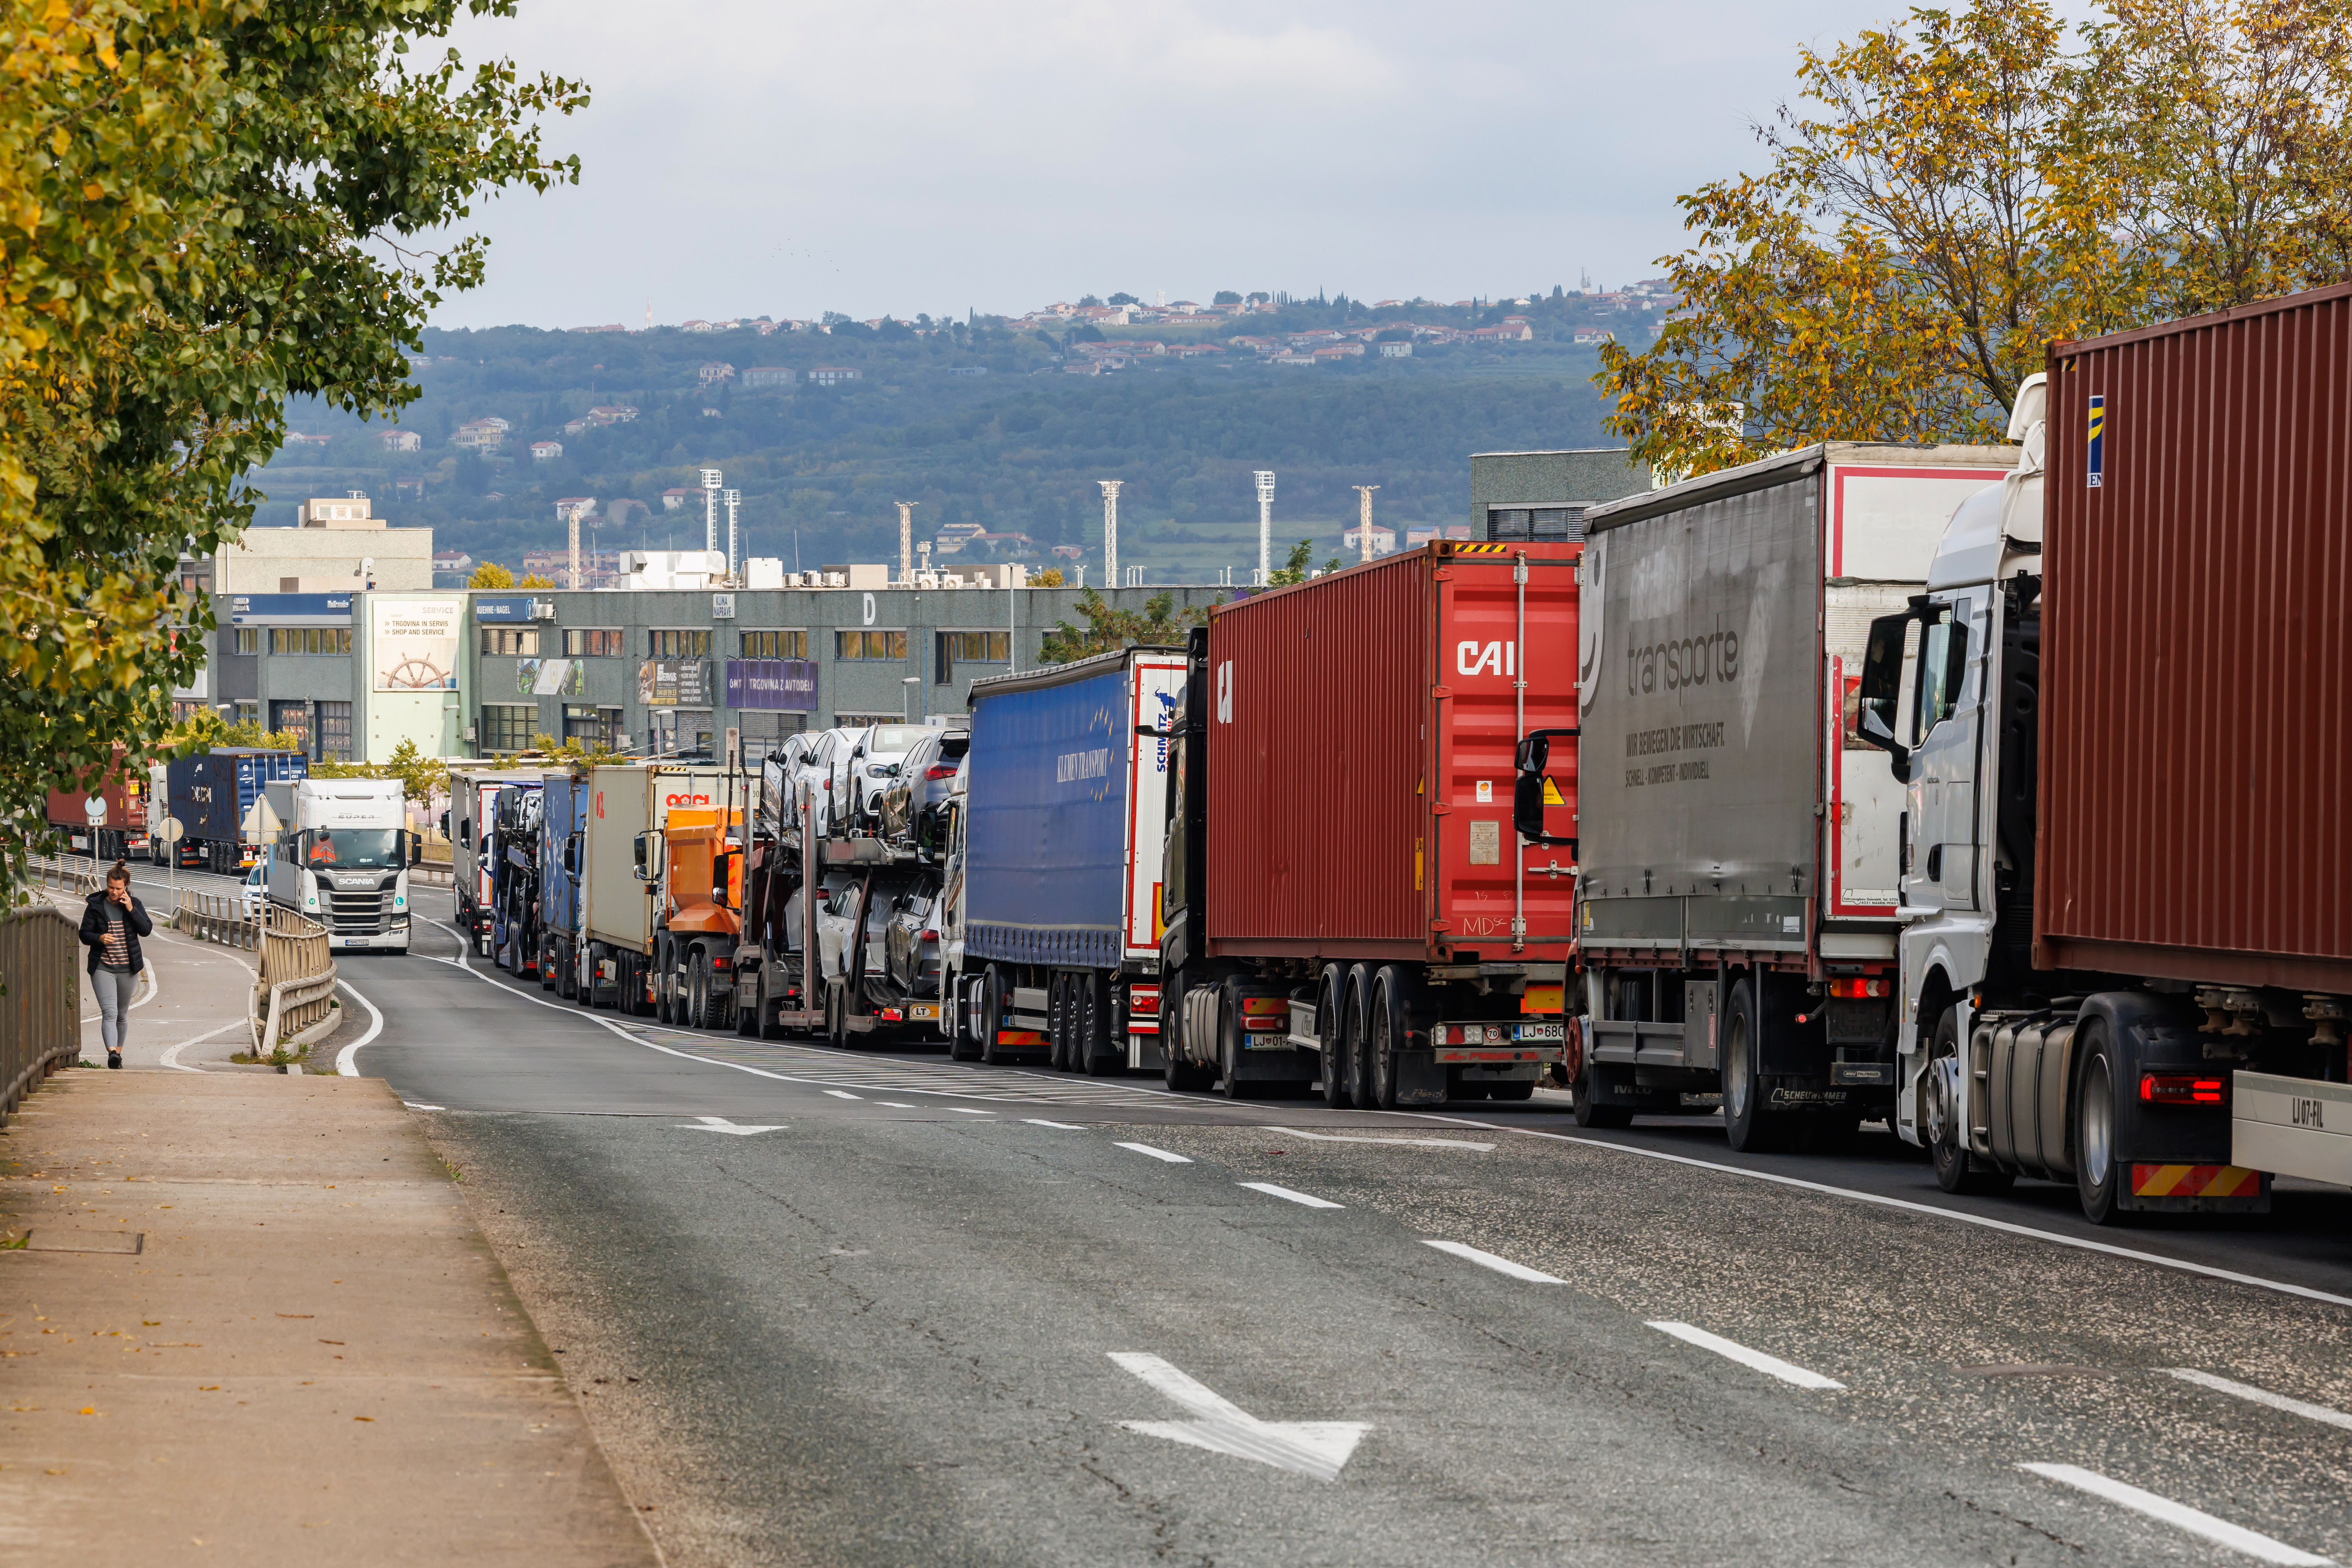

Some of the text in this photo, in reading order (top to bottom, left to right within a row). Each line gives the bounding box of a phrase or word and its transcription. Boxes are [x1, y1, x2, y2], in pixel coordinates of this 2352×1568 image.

[716, 596, 728, 606] KLIMA
[477, 606, 510, 614] KUEHNE+NAGEL
[714, 606, 731, 617] NAPRAVE
[863, 593, 876, 626] D
[1457, 641, 1514, 675] CAI
[1628, 613, 1738, 707] transporte
[657, 664, 677, 682] SERVUS
[730, 679, 813, 691] GMT TRGOVINA Z AVTODELI
[1626, 722, 1725, 757] WIR BEWEGEN DIE WIRTSCHAFT.
[1057, 748, 1108, 783] KLEMEN TRANSPORT
[1626, 768, 1644, 788] SCHNELL
[1648, 764, 1675, 785] KOMPETENT
[1679, 761, 1710, 781] INDIVIDUELL
[916, 1007, 927, 1016] LT
[1523, 1025, 1536, 1038] LJ
[1254, 1036, 1265, 1046] LJ
[1614, 1085, 1652, 1094] IVECO
[2293, 1097, 2323, 1128] LJ 07-FIL
